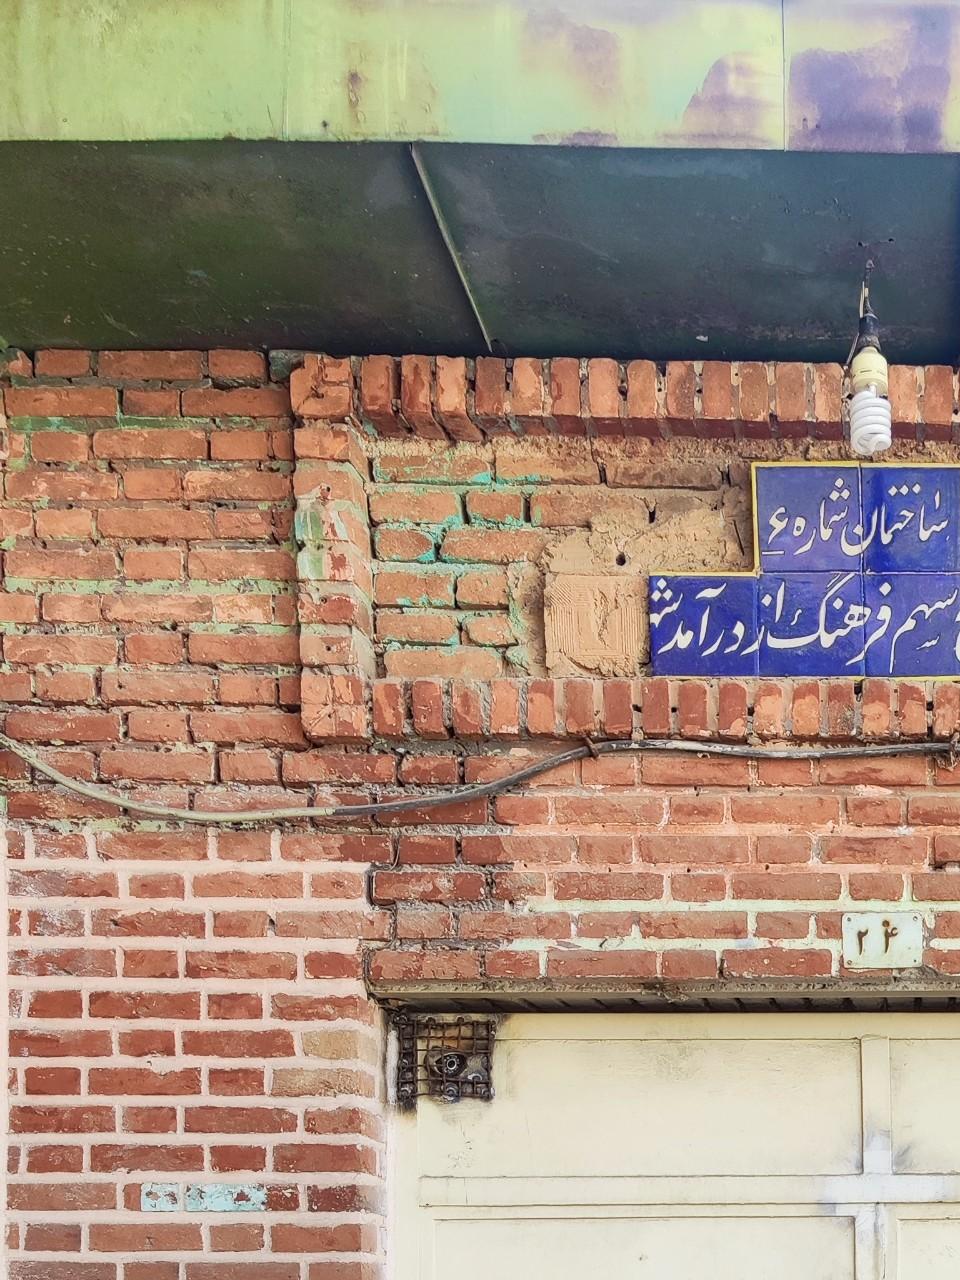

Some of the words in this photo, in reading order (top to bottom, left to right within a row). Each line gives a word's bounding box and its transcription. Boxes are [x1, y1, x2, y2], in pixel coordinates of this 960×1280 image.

[793, 477, 851, 555] شماره
[840, 483, 949, 556] ساختمان
[657, 582, 746, 656] درآمد
[739, 581, 786, 656] از
[766, 571, 893, 676] فرهنگ
[889, 588, 958, 675] سهم
